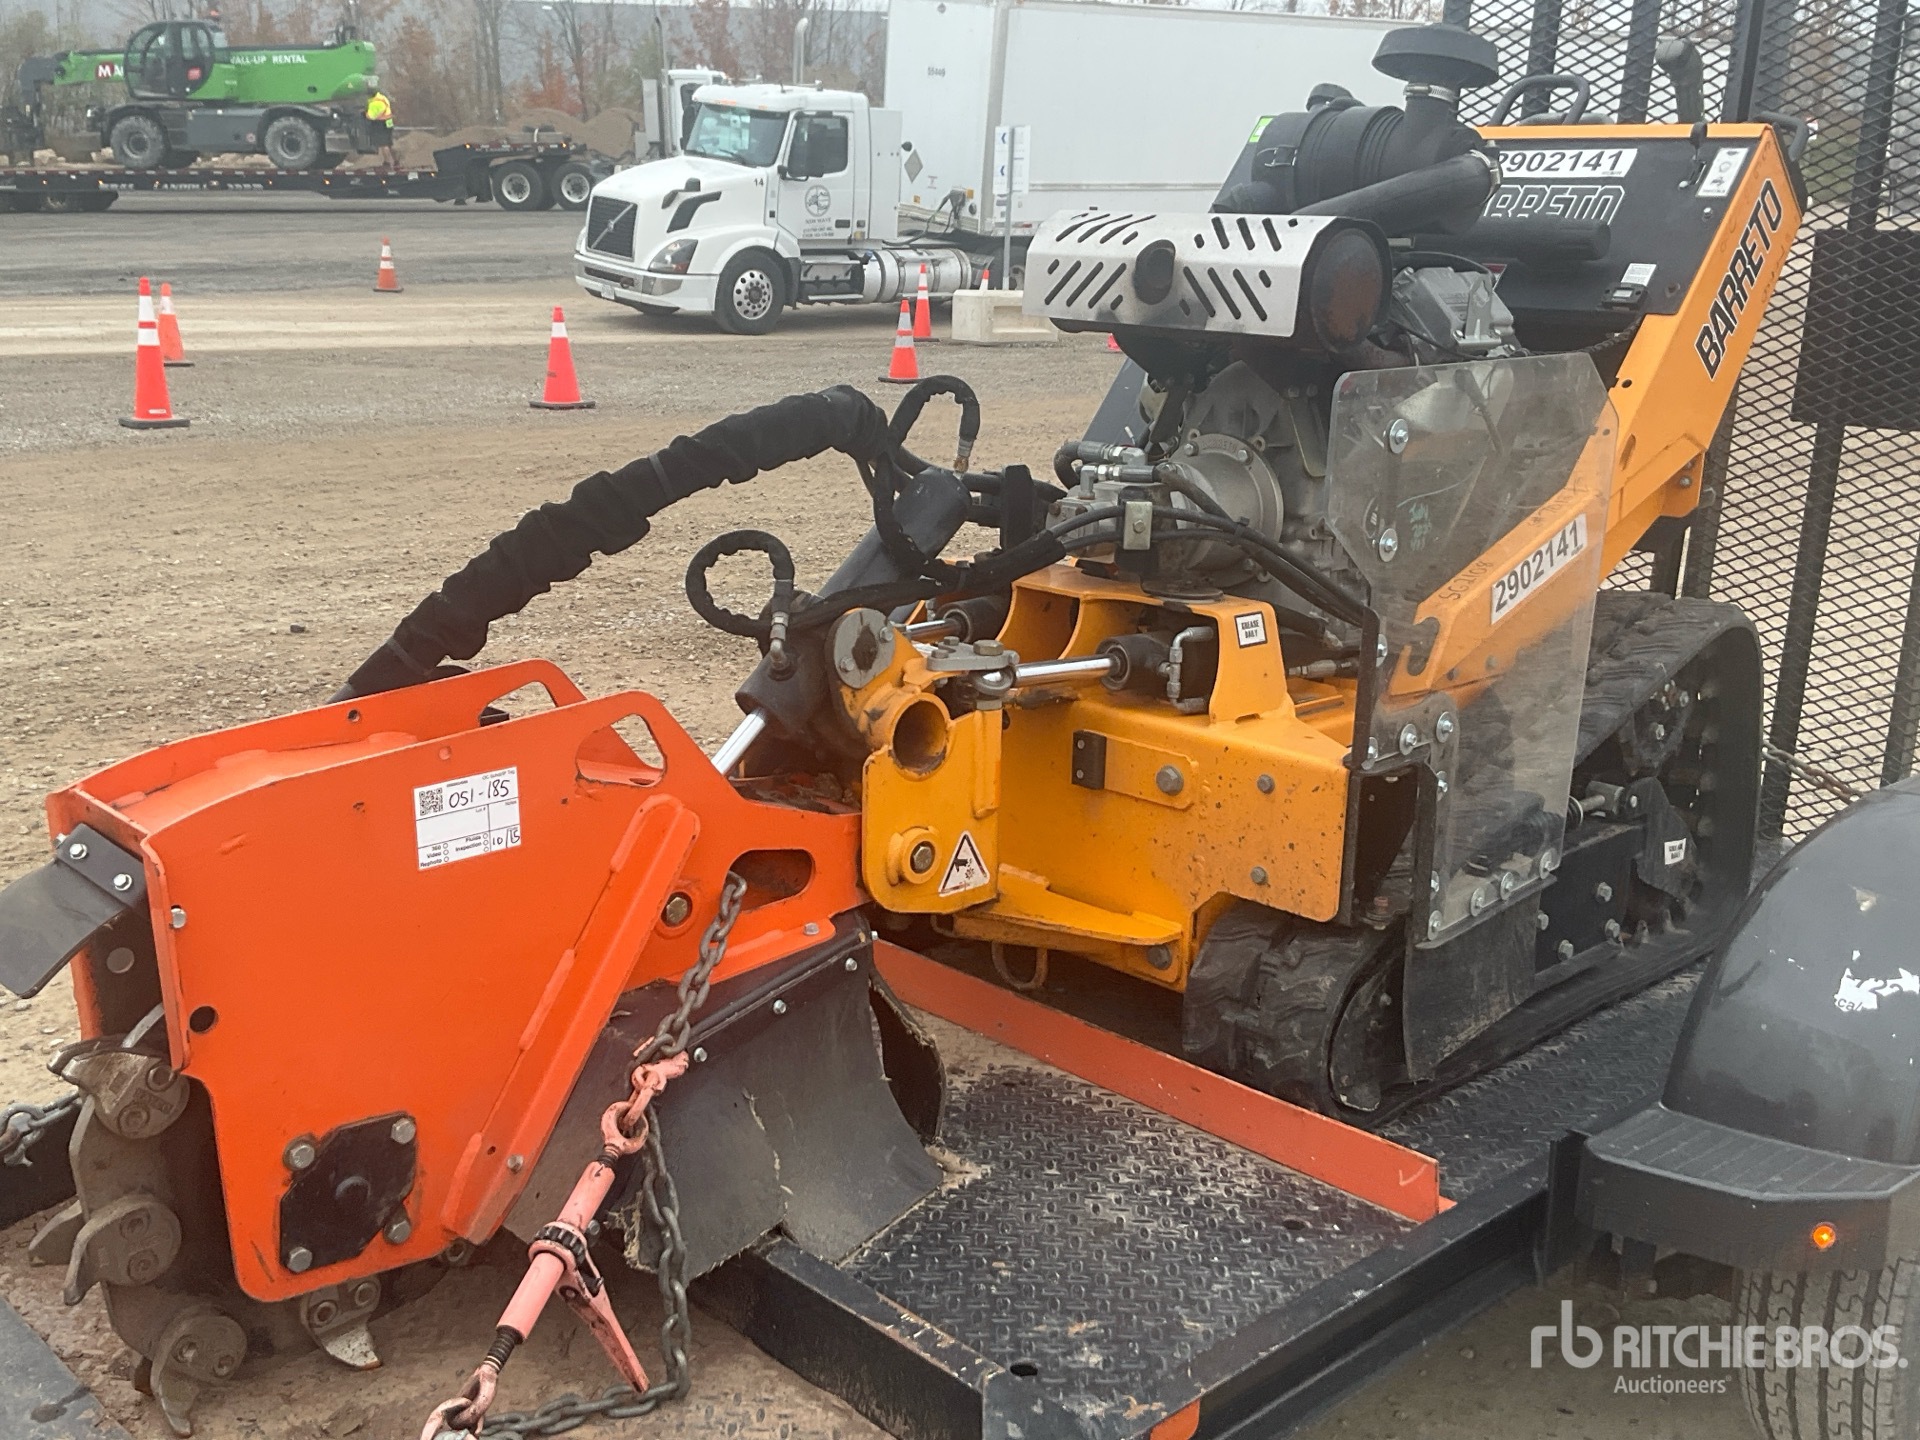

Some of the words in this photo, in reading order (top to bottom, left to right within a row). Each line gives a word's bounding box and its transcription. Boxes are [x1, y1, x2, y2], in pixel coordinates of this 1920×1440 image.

[272, 54, 308, 64] RENTAL
[754, 178, 764, 186] 14
[1694, 178, 1783, 382] BARRETO
[1494, 519, 1579, 614] 2902141
[426, 851, 442, 860] Video
